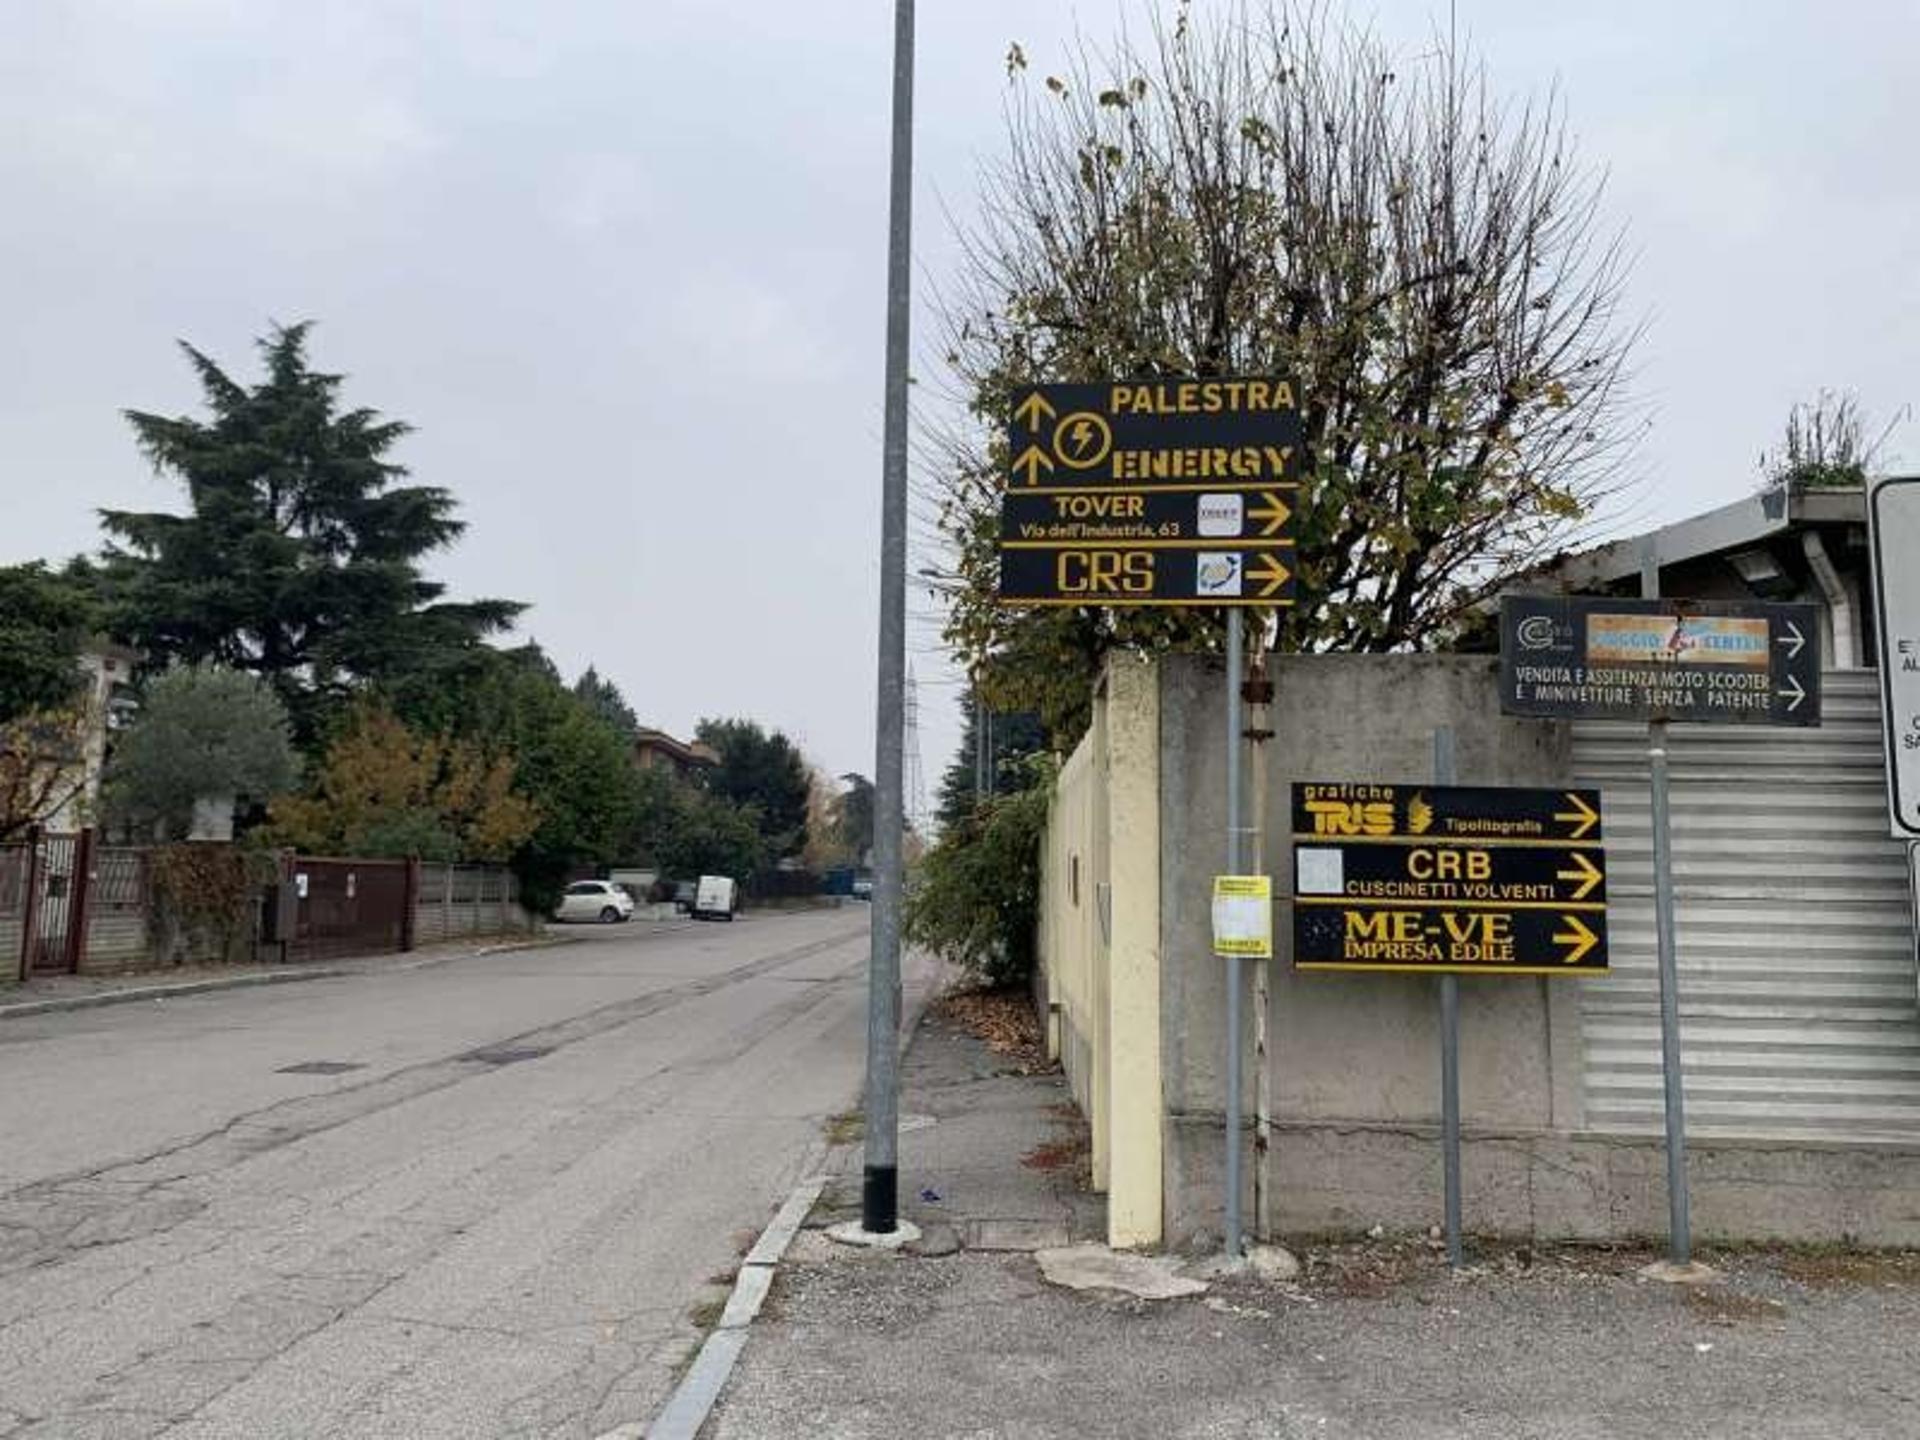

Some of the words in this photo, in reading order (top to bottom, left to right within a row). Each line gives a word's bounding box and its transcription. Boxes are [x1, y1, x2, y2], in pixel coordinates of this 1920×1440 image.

[1111, 381, 1296, 414] PALESTRA
[1112, 446, 1294, 479] ENERGY
[1056, 495, 1144, 518] TOVER
[1018, 523, 1045, 538] Via
[1158, 521, 1181, 537] 63
[1057, 550, 1155, 592] CRS
[1516, 666, 1571, 683] VENDITA
[1659, 671, 1703, 688] MOTO
[1707, 673, 1770, 690] SCOOTER
[1645, 689, 1695, 707] SENZA
[1707, 691, 1771, 710] PATENTE
[1304, 783, 1394, 800] grafiche
[1304, 801, 1395, 835] TRIS
[1408, 849, 1493, 880] CRB
[1346, 880, 1458, 897] CUSCINETTI
[1463, 882, 1555, 899] VOLVENTI
[1344, 910, 1515, 945] ME-VE
[1344, 941, 1443, 961] IMPRESA
[1451, 943, 1516, 961] EDILE
